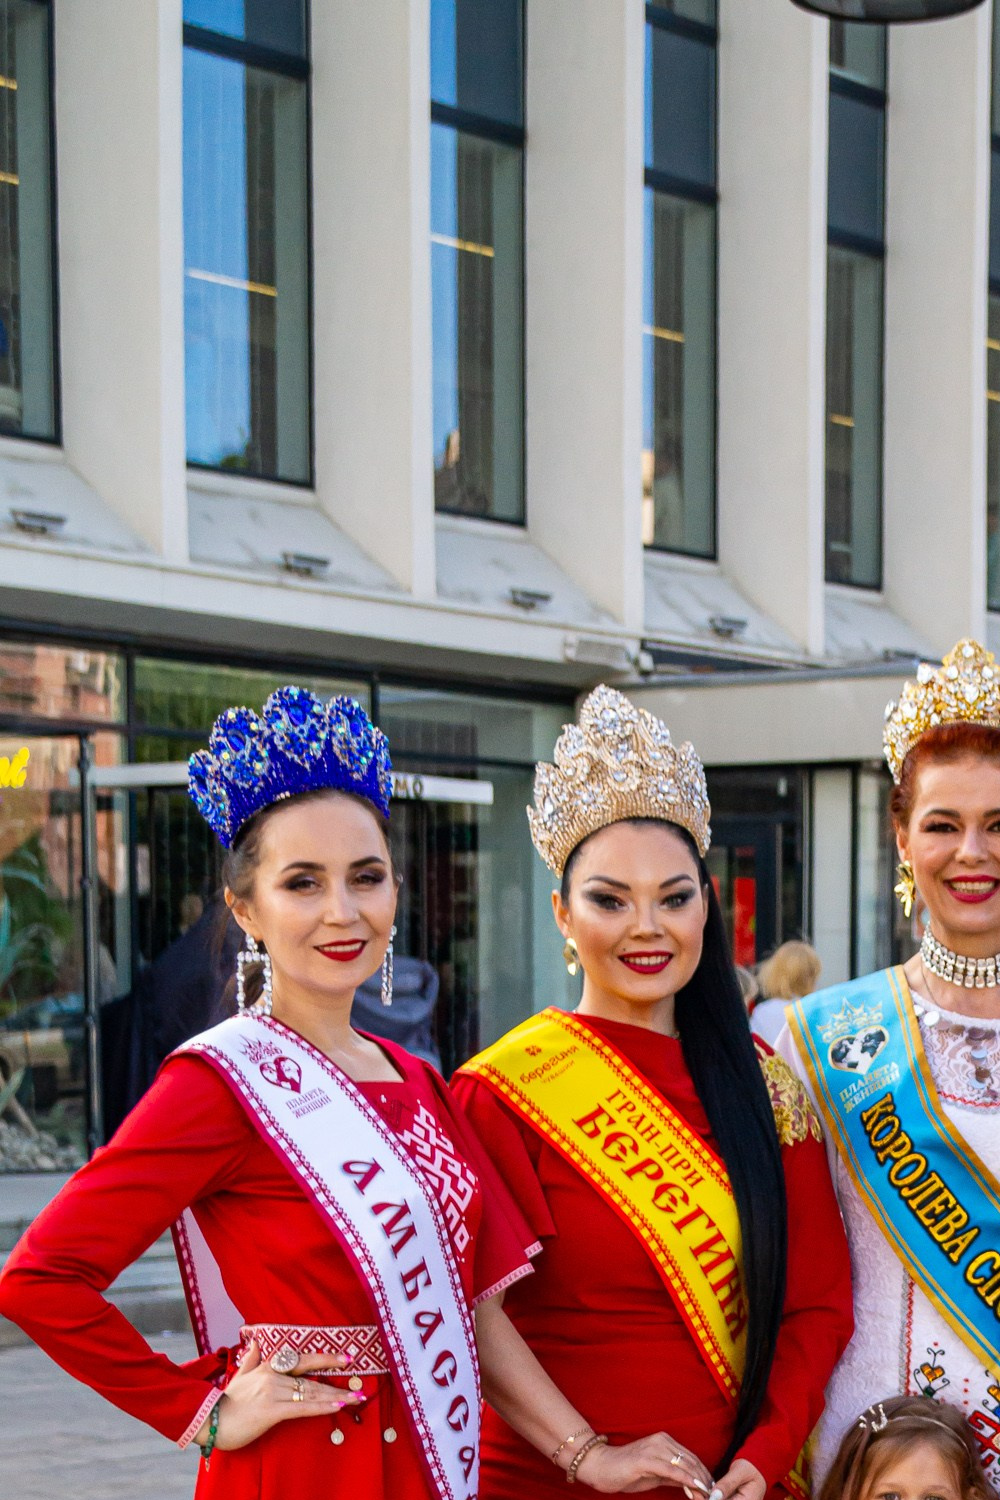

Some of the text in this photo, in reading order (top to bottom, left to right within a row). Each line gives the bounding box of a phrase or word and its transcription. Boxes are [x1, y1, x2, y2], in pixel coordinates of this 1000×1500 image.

[519, 1045, 579, 1084] берегиня
[839, 1062, 899, 1102] ПЛАНЕТА
[285, 1087, 325, 1110] ПЛАНЕТА
[292, 1095, 332, 1119] ЖЕНЩИН
[605, 1088, 706, 1189] ГРАН-ПРИ
[860, 1093, 980, 1264] КОРОЛЕВА
[572, 1103, 748, 1344] БЕРЕГИНЯ
